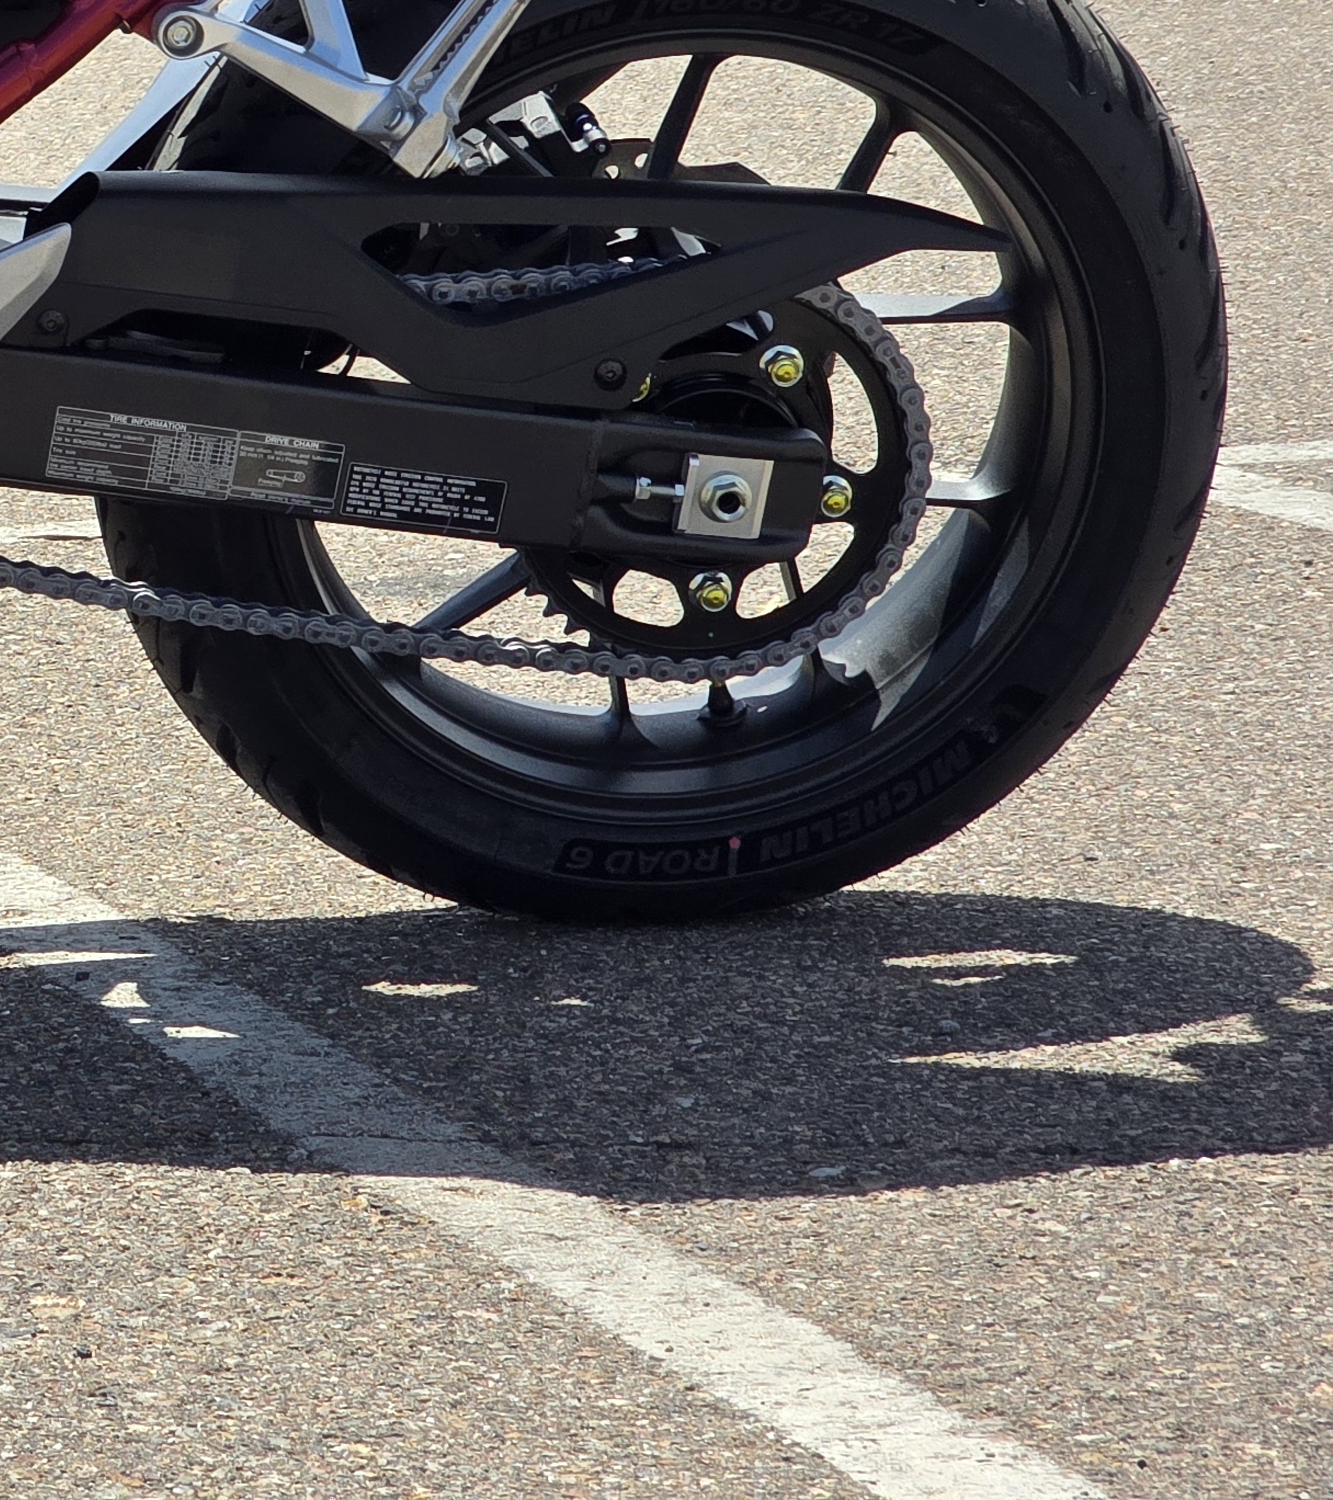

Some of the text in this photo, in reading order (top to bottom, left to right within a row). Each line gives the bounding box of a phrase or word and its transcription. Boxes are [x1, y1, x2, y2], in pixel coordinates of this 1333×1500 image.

[808, 2, 870, 31] ZR
[880, 22, 926, 46] 17
[109, 414, 128, 424] TIRE
[130, 417, 187, 433] INFORMATION
[264, 435, 320, 450] DRIVE CHAIN
[565, 739, 974, 876] MICHELIN ROAD 6
